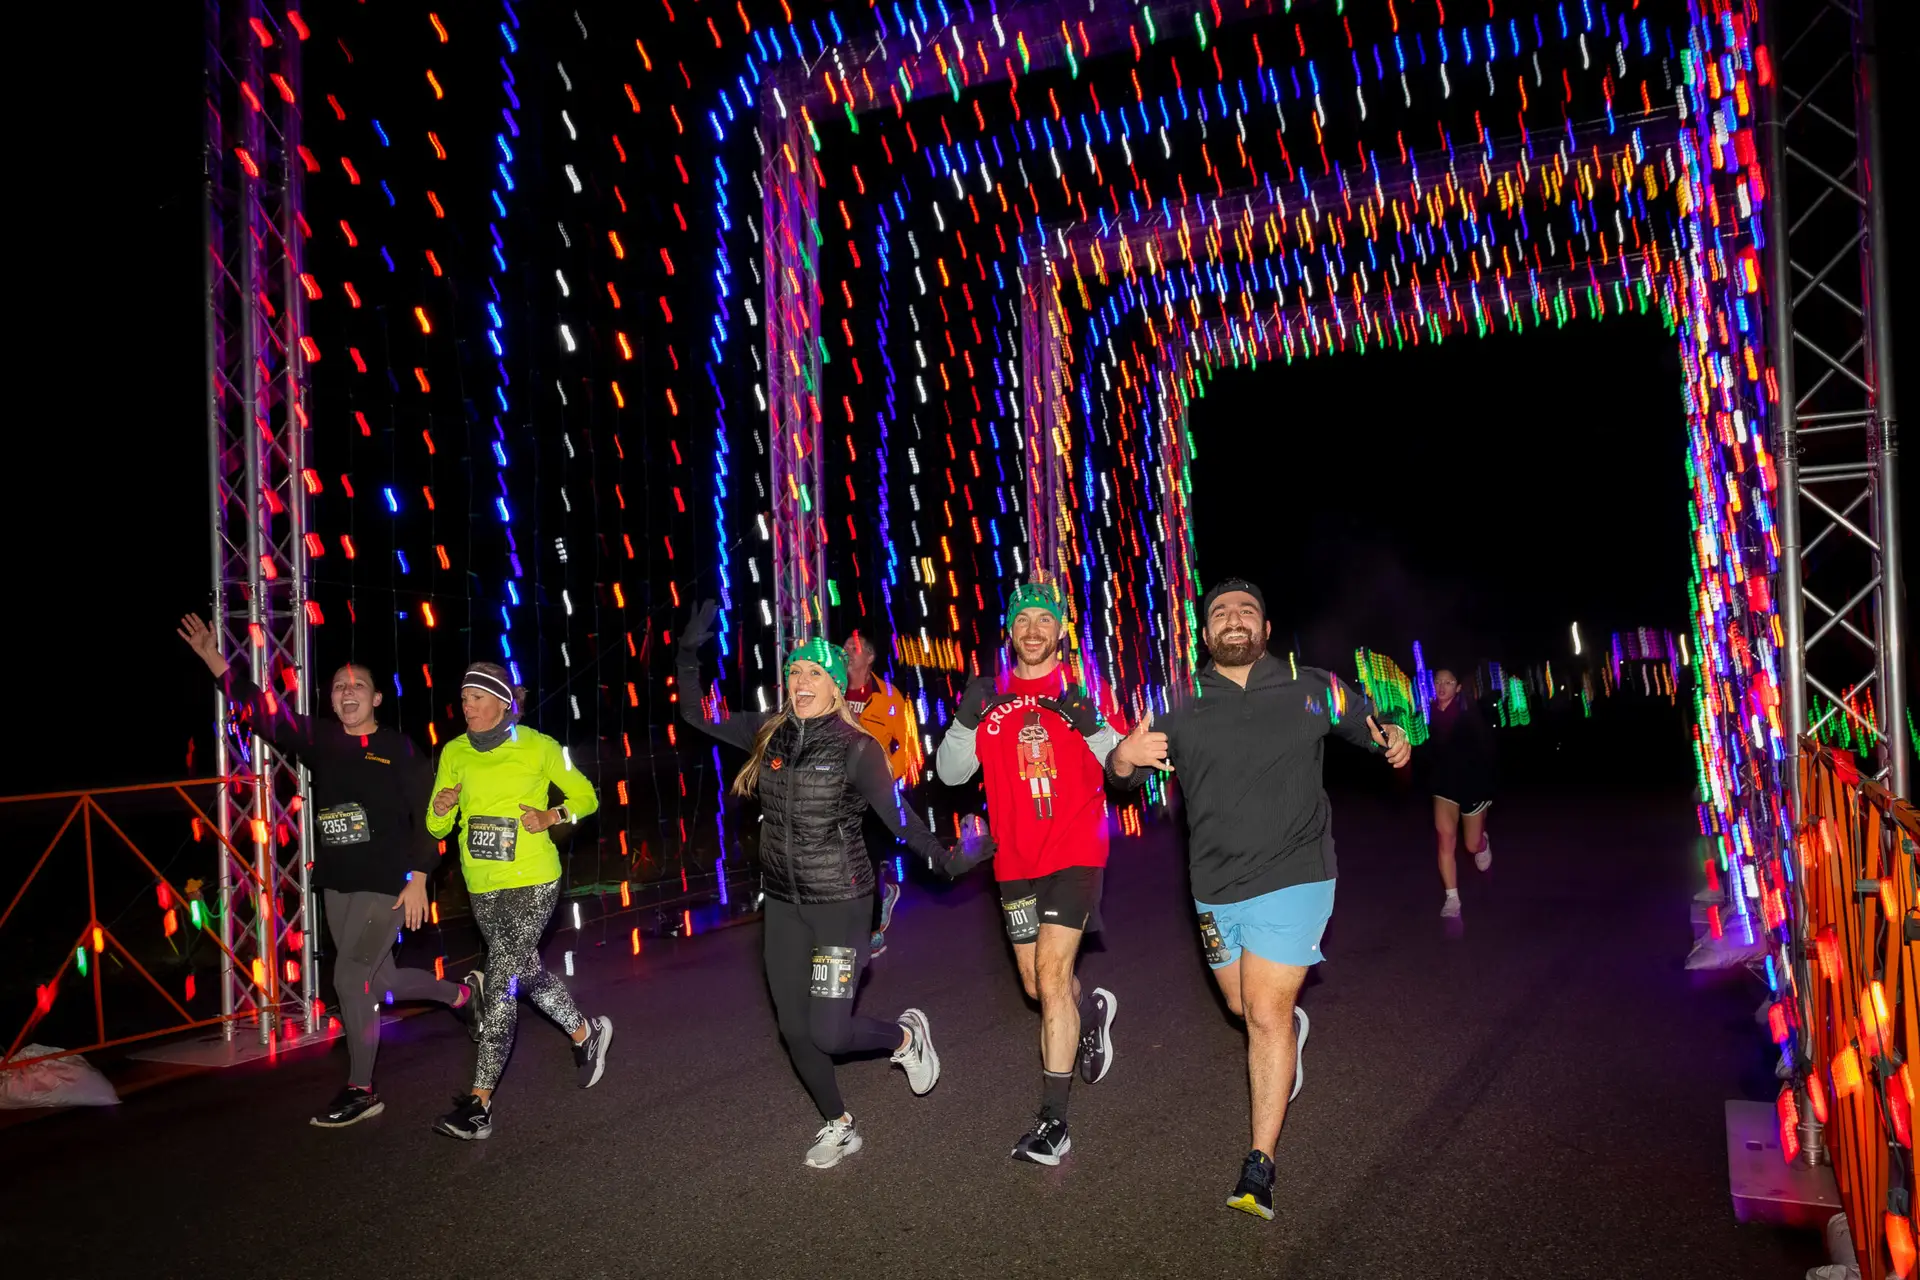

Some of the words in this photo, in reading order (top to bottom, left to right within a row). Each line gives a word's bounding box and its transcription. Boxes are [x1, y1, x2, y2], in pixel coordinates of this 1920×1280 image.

[322, 817, 348, 834] 2355
[472, 830, 496, 847] 2322
[1008, 909, 1029, 926] 701
[811, 964, 828, 981] 700
